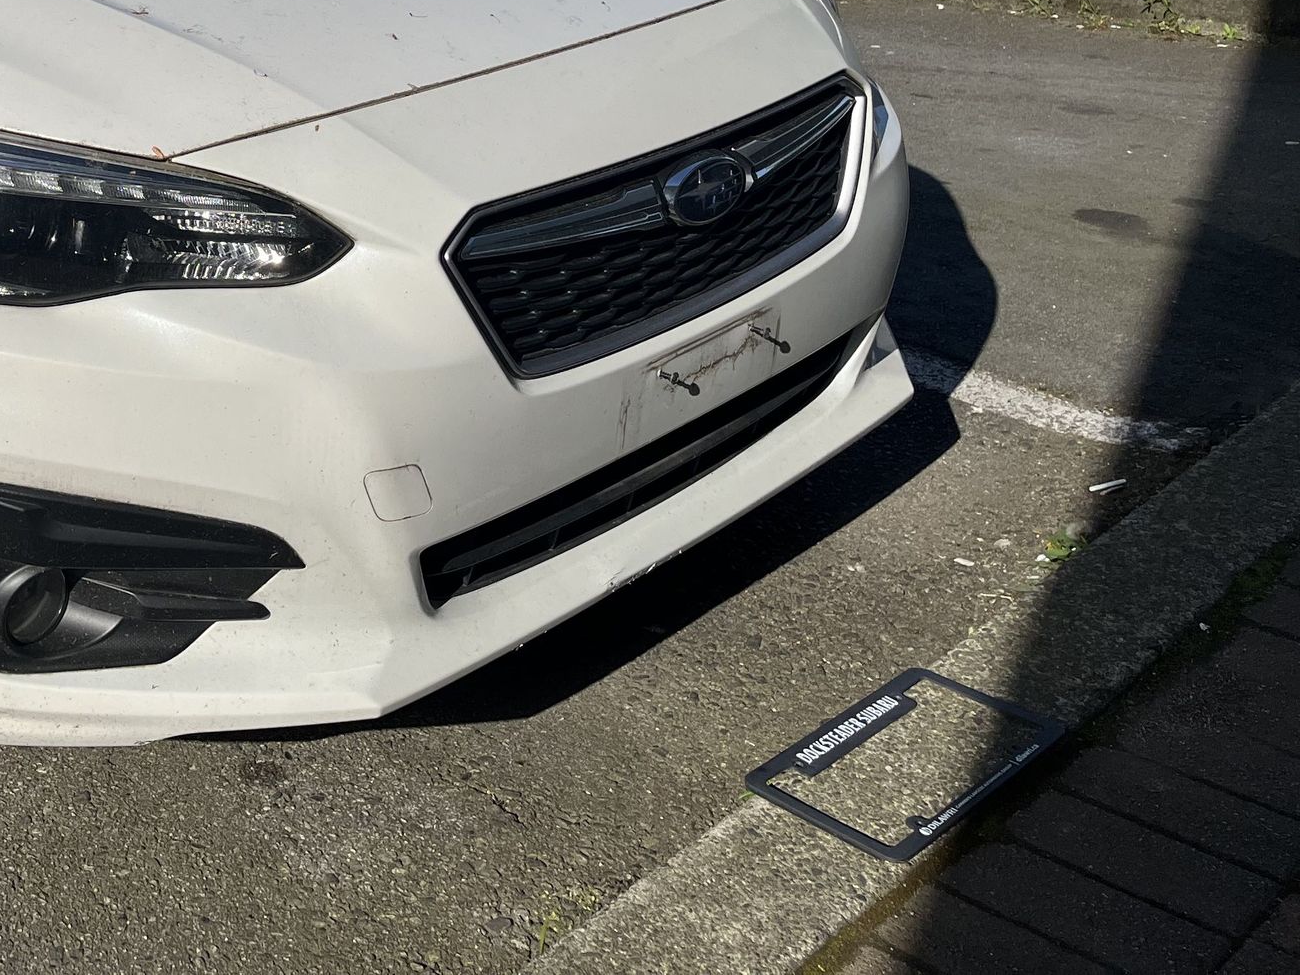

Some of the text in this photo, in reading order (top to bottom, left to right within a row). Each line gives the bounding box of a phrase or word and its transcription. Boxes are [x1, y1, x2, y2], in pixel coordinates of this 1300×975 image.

[795, 695, 899, 765] DOCKSTEADER SUBARU
[927, 807, 959, 831] DILAWRI
